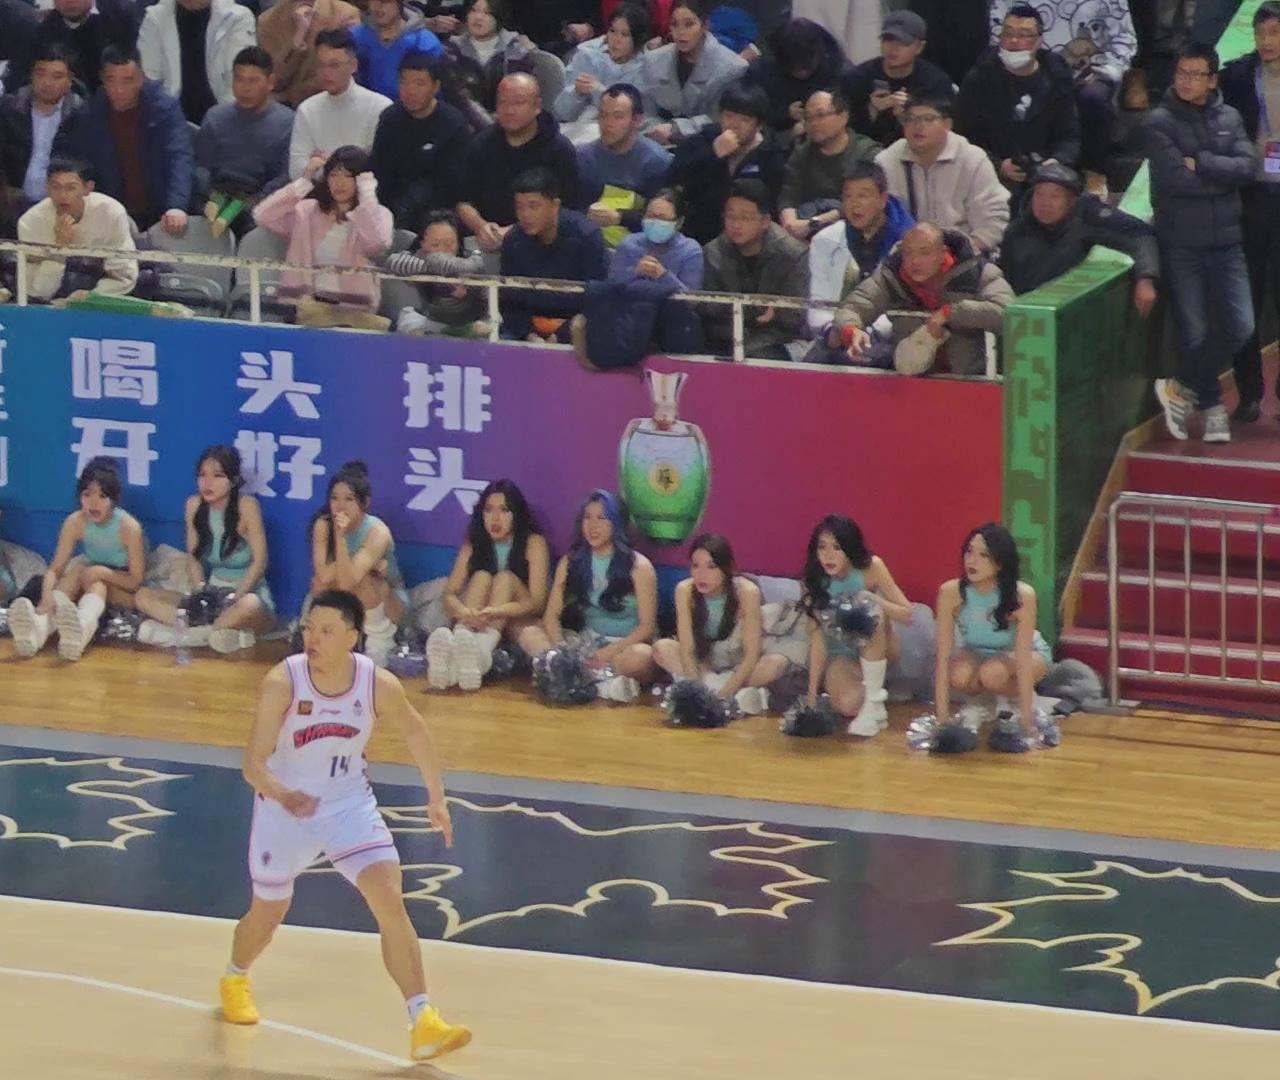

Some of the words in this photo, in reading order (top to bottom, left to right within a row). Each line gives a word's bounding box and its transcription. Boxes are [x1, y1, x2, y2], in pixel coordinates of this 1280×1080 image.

[70, 338, 491, 433] 喝头排
[330, 755, 352, 777] 14
